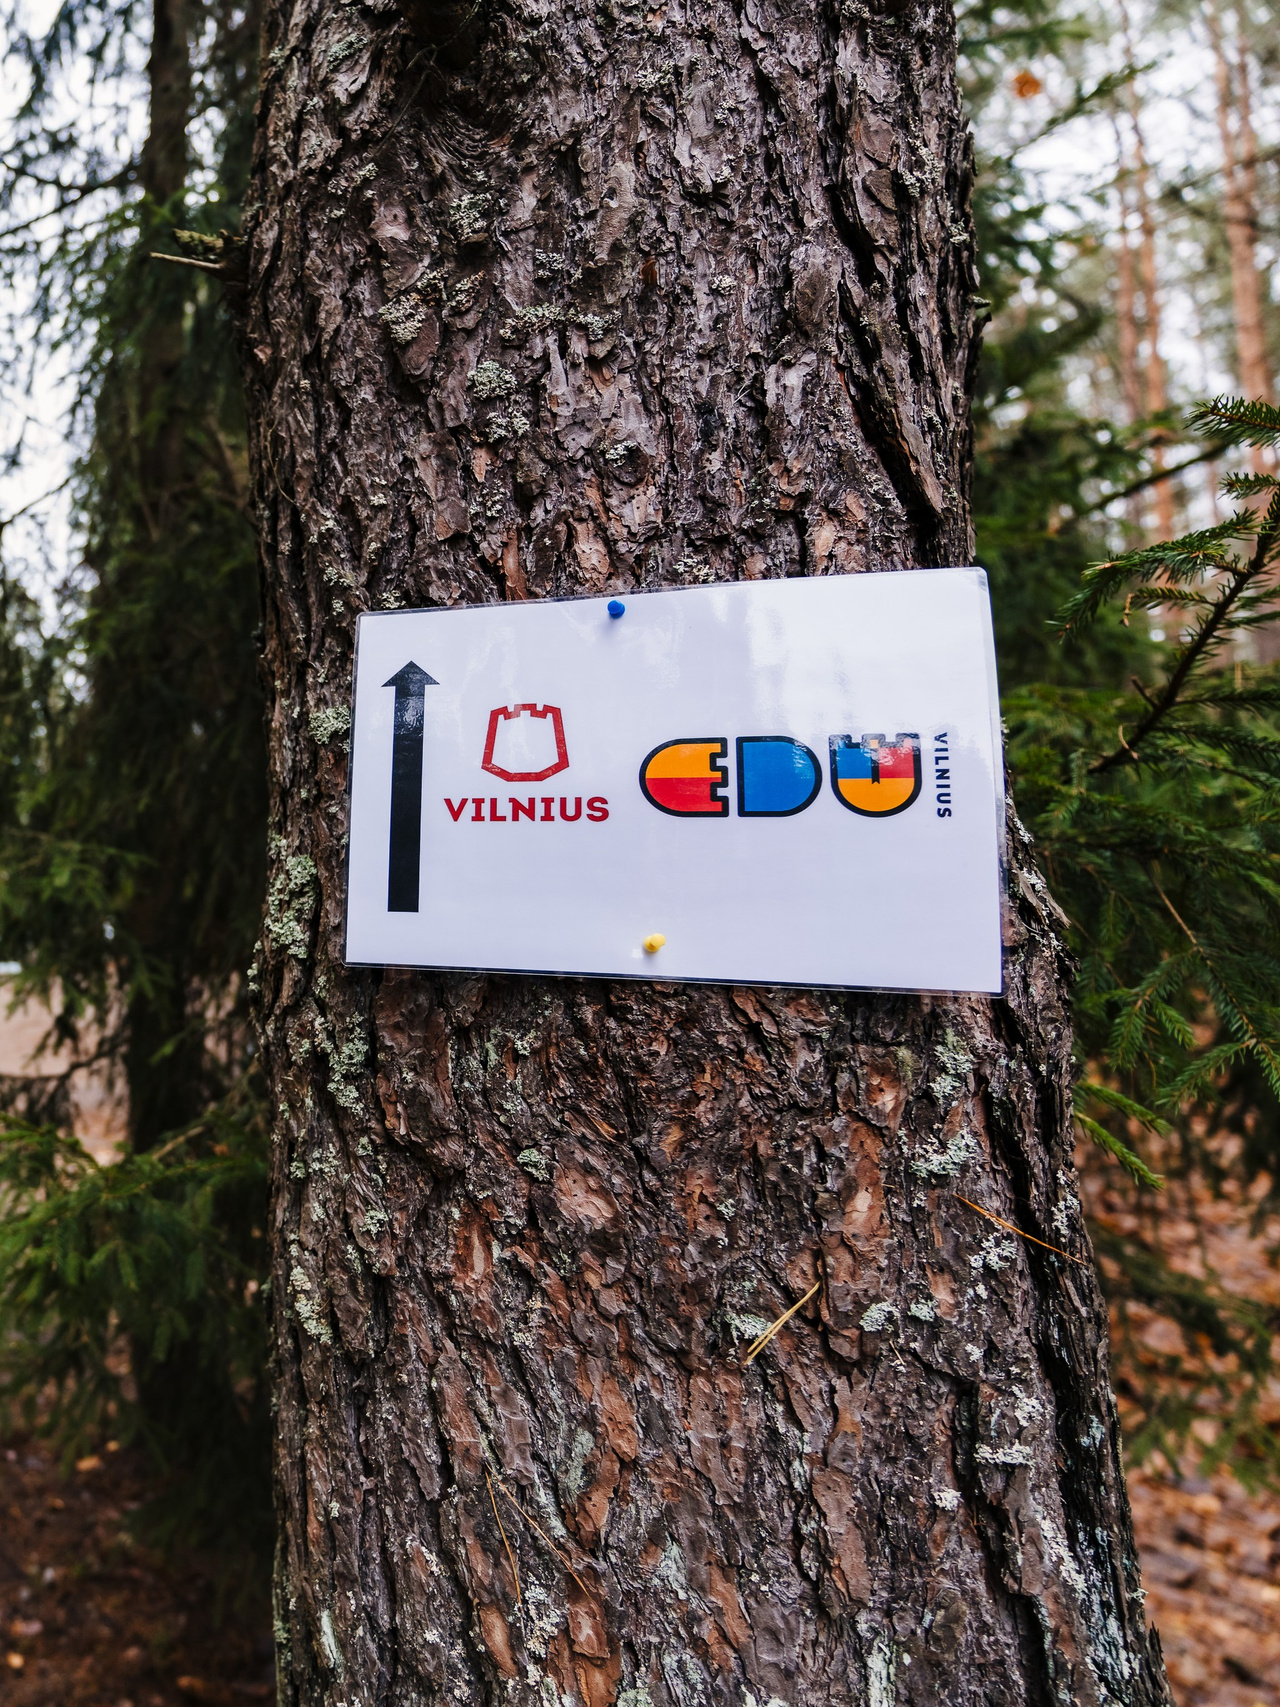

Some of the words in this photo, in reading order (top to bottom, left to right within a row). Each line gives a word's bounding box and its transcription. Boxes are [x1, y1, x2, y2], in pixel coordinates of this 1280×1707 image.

[444, 796, 609, 823] VILNIUS
[639, 732, 922, 818] EDU
[934, 731, 952, 819] VILNIUS
